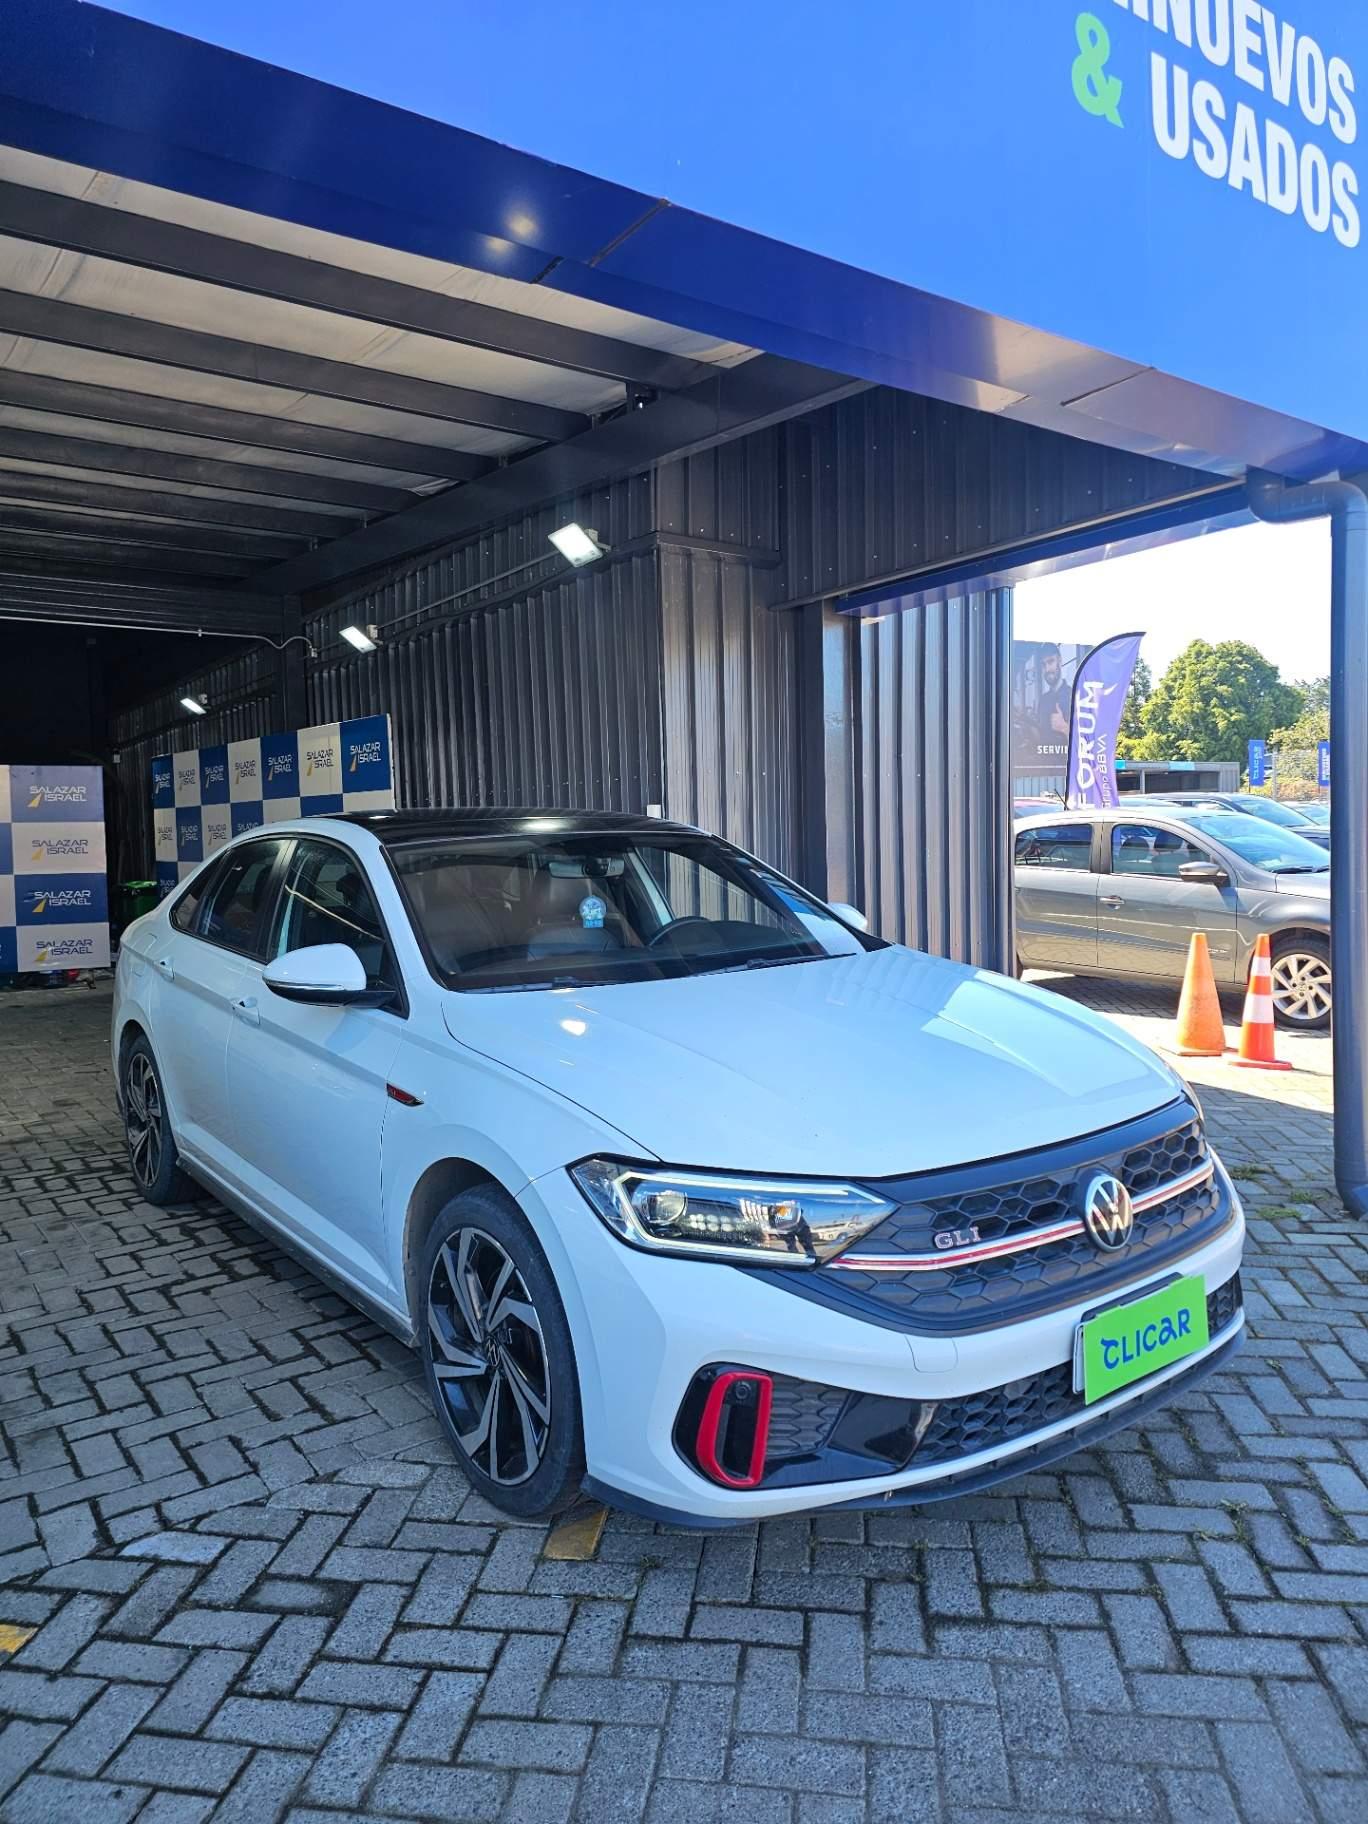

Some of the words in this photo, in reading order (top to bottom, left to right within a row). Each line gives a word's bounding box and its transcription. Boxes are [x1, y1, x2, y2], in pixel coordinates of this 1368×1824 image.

[1113, 0, 1358, 145] UEVOS
[1072, 12, 1125, 128] &
[1150, 51, 1361, 249] USADOS
[350, 741, 381, 755] SALAZAR
[1076, 681, 1104, 809] FORUM
[306, 748, 334, 760] SALAZAR
[357, 752, 382, 764] ISRAEL
[1097, 733, 1108, 774] BBVA
[235, 759, 256, 770] SALAZAR
[268, 754, 293, 766] SALAZAR
[314, 758, 335, 769] ISRAEL
[29, 785, 87, 795] SALAZAR
[44, 793, 88, 802] ISRAEL
[32, 839, 89, 848] SALAZAR
[46, 846, 89, 856] ISRAEL
[34, 889, 91, 900] SALAZAR
[48, 897, 92, 907] ISRAEL
[36, 938, 93, 949] SALAZAR
[50, 947, 93, 957] ISRAEL
[934, 1227, 982, 1250] GLI
